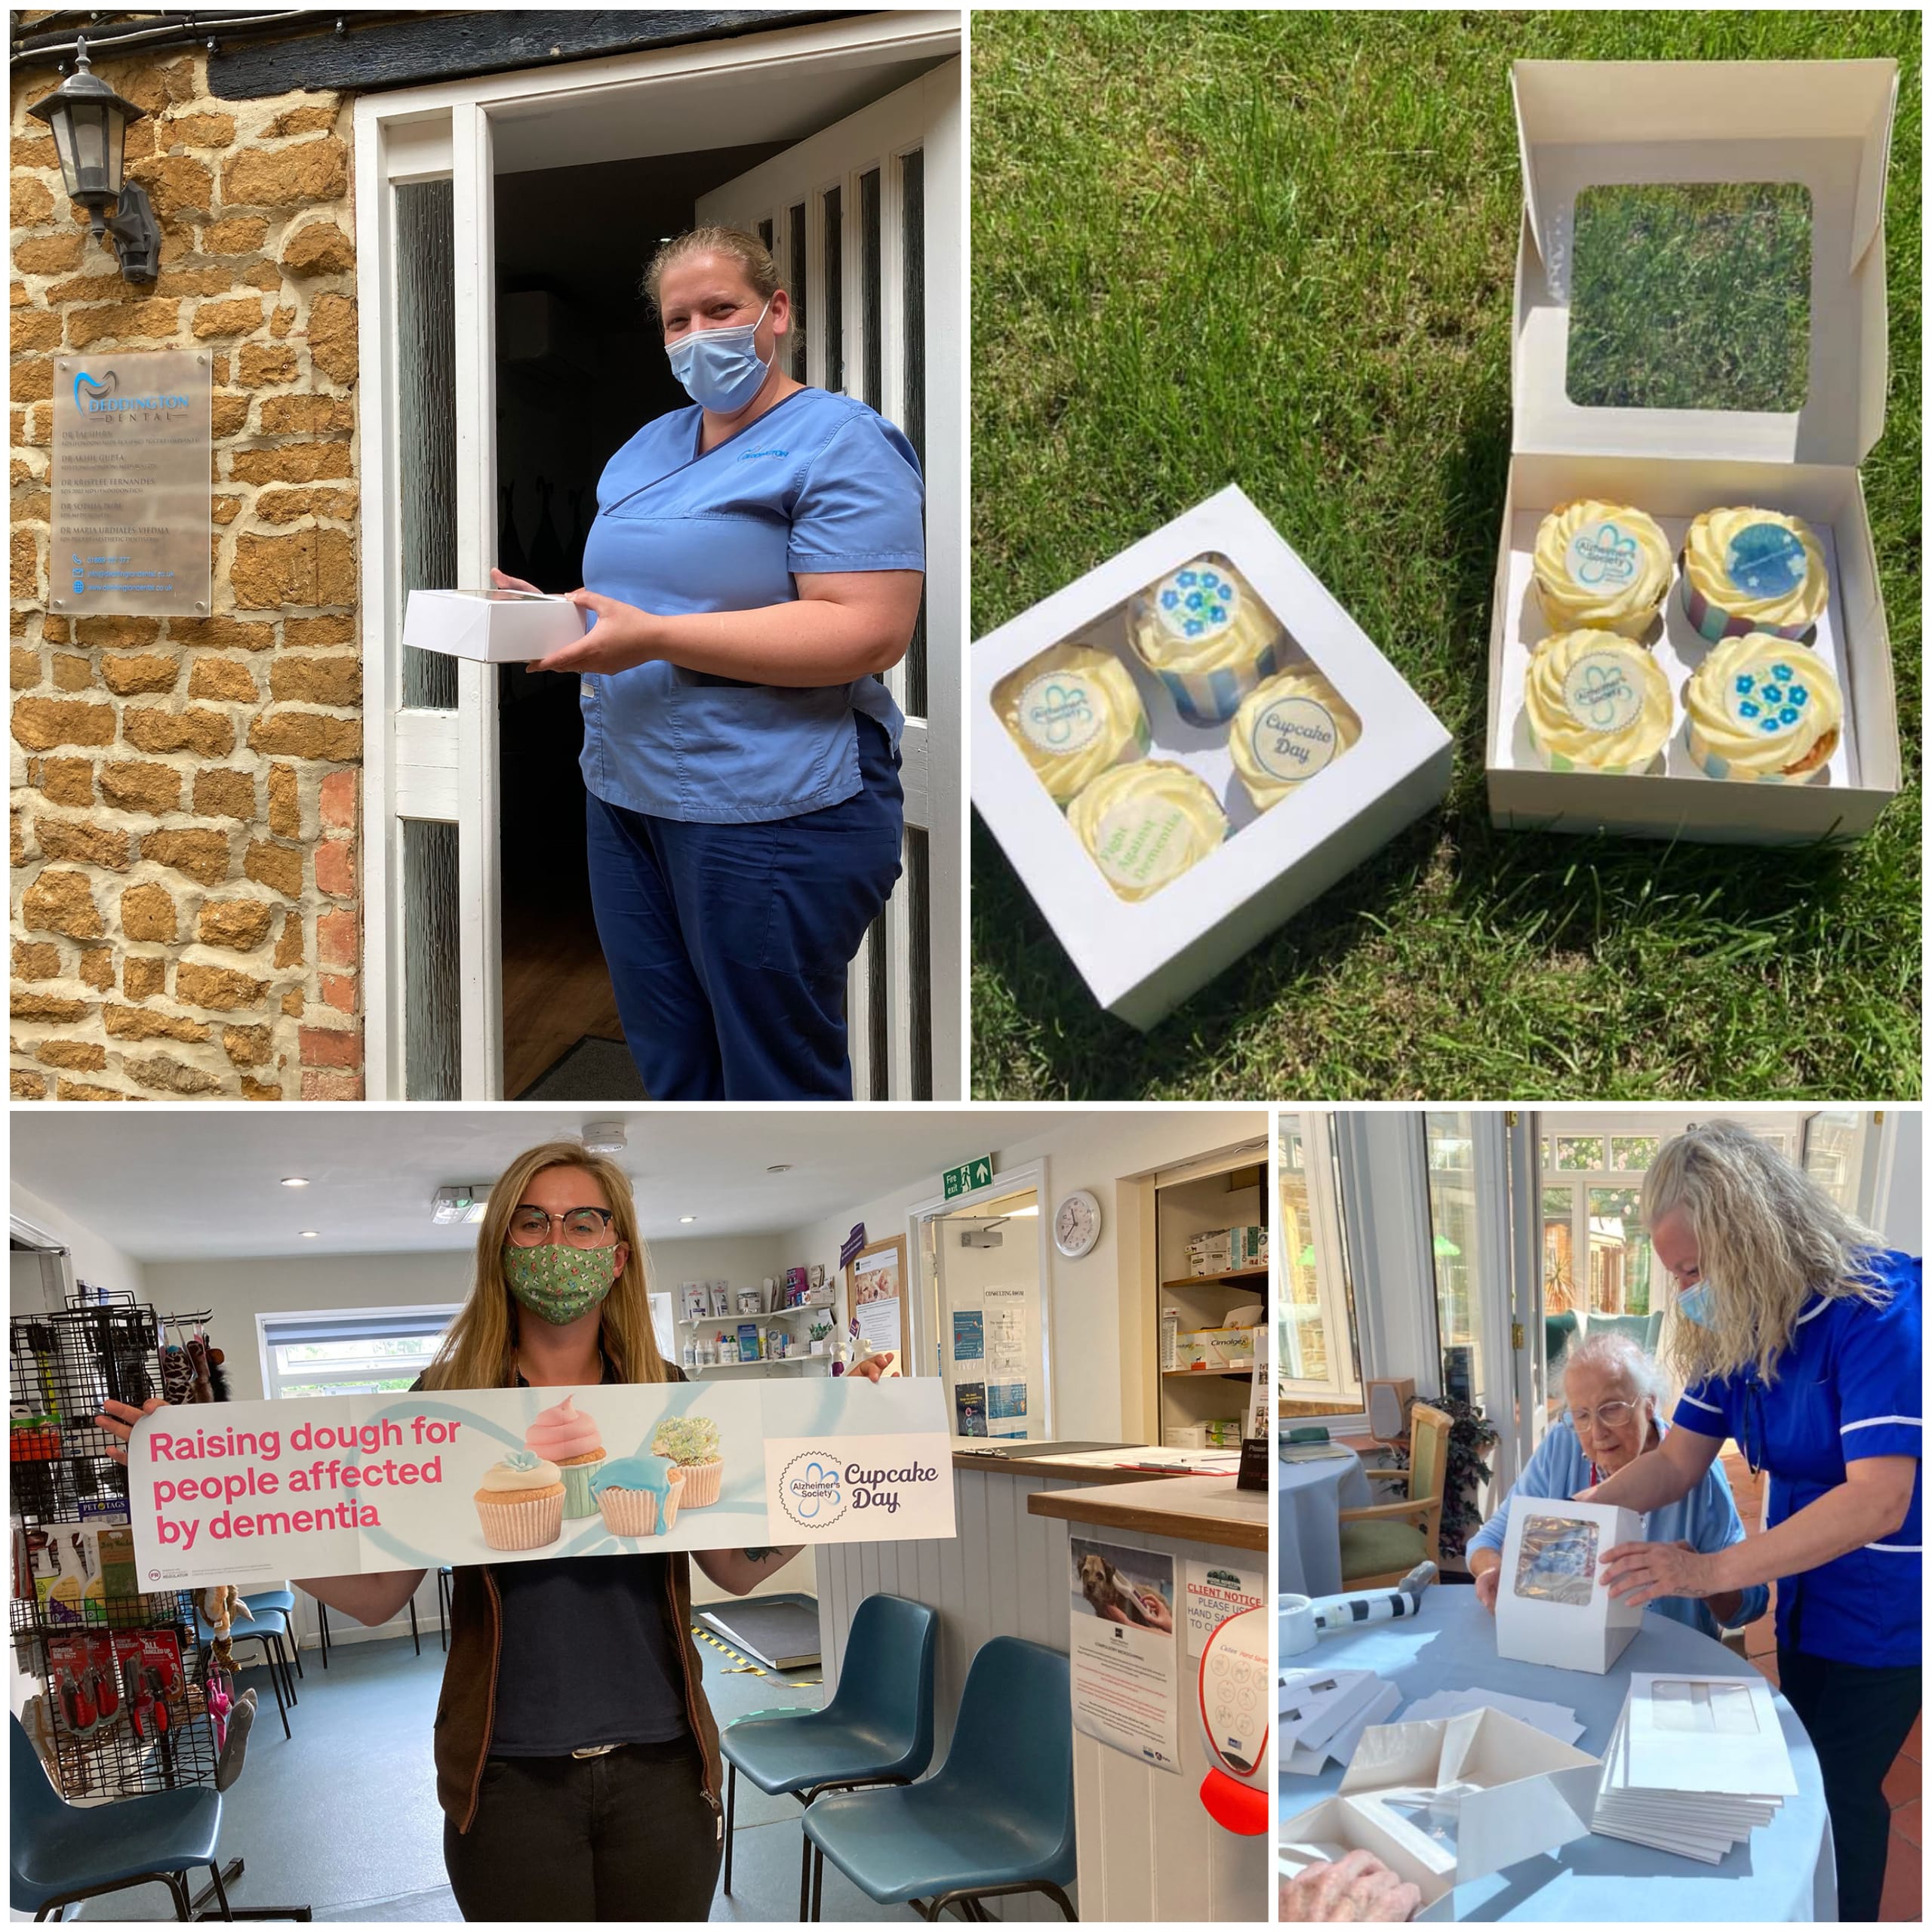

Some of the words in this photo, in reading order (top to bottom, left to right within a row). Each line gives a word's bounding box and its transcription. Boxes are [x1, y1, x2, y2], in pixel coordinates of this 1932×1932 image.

[89, 395, 189, 412] DEDDINGTON
[105, 412, 172, 423] DENTAL
[1266, 713, 1332, 743] Cupcake
[1274, 738, 1311, 764] Day
[946, 1174, 957, 1184] Fire
[947, 1183, 958, 1195] exit
[149, 1429, 280, 1462] Raising
[290, 1417, 403, 1455] dough
[411, 1415, 461, 1445] for
[153, 1467, 279, 1510] people
[288, 1456, 442, 1493] affected
[844, 1461, 939, 1491] Cupcake
[793, 1481, 840, 1491] Alzheimer's
[801, 1490, 832, 1499] Society
[852, 1487, 900, 1514] Day
[106, 1501, 125, 1509] TAGS
[156, 1515, 200, 1551] by
[209, 1499, 380, 1540] dementia
[1187, 1583, 1221, 1598] CLIENT
[1224, 1591, 1262, 1606] NOTICE
[1198, 1597, 1230, 1612] PLEASE
[1188, 1607, 1212, 1620] HAND
[1189, 1618, 1202, 1629] TO
[144, 1641, 159, 1650] ALL
